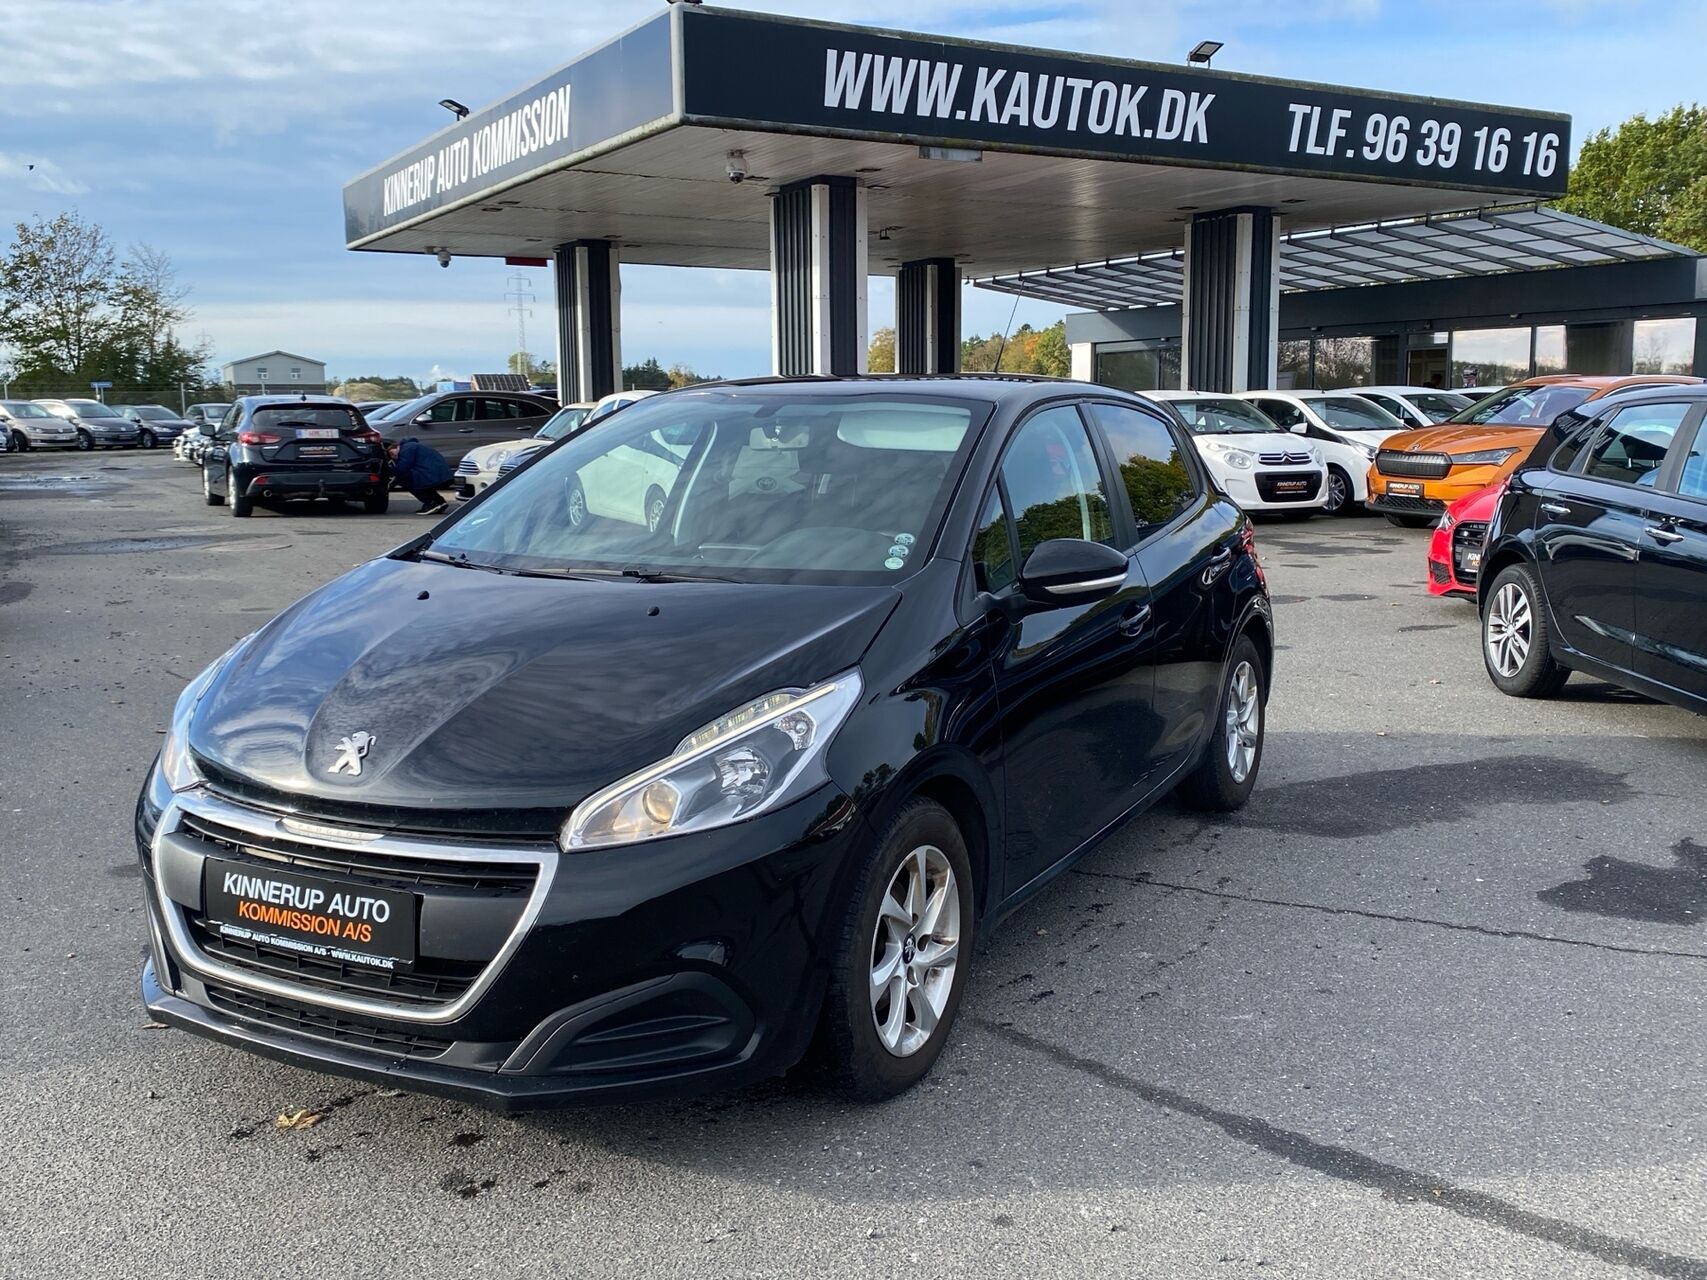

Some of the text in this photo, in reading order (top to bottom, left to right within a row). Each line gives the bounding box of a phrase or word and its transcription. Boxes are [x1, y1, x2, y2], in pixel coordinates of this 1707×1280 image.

[824, 48, 1216, 144] WWW.KAUTOK.DK
[384, 84, 571, 216] KINNERUP AUTO KOMMISSION
[1288, 103, 1560, 177] TLF. 96 39 16 16
[223, 872, 390, 923] KINNERUP AUTO
[238, 901, 372, 943] KOMMISSION A/S
[252, 934, 270, 944] AUTO
[270, 937, 313, 953] KOMMISSION
[314, 946, 327, 956] A/S
